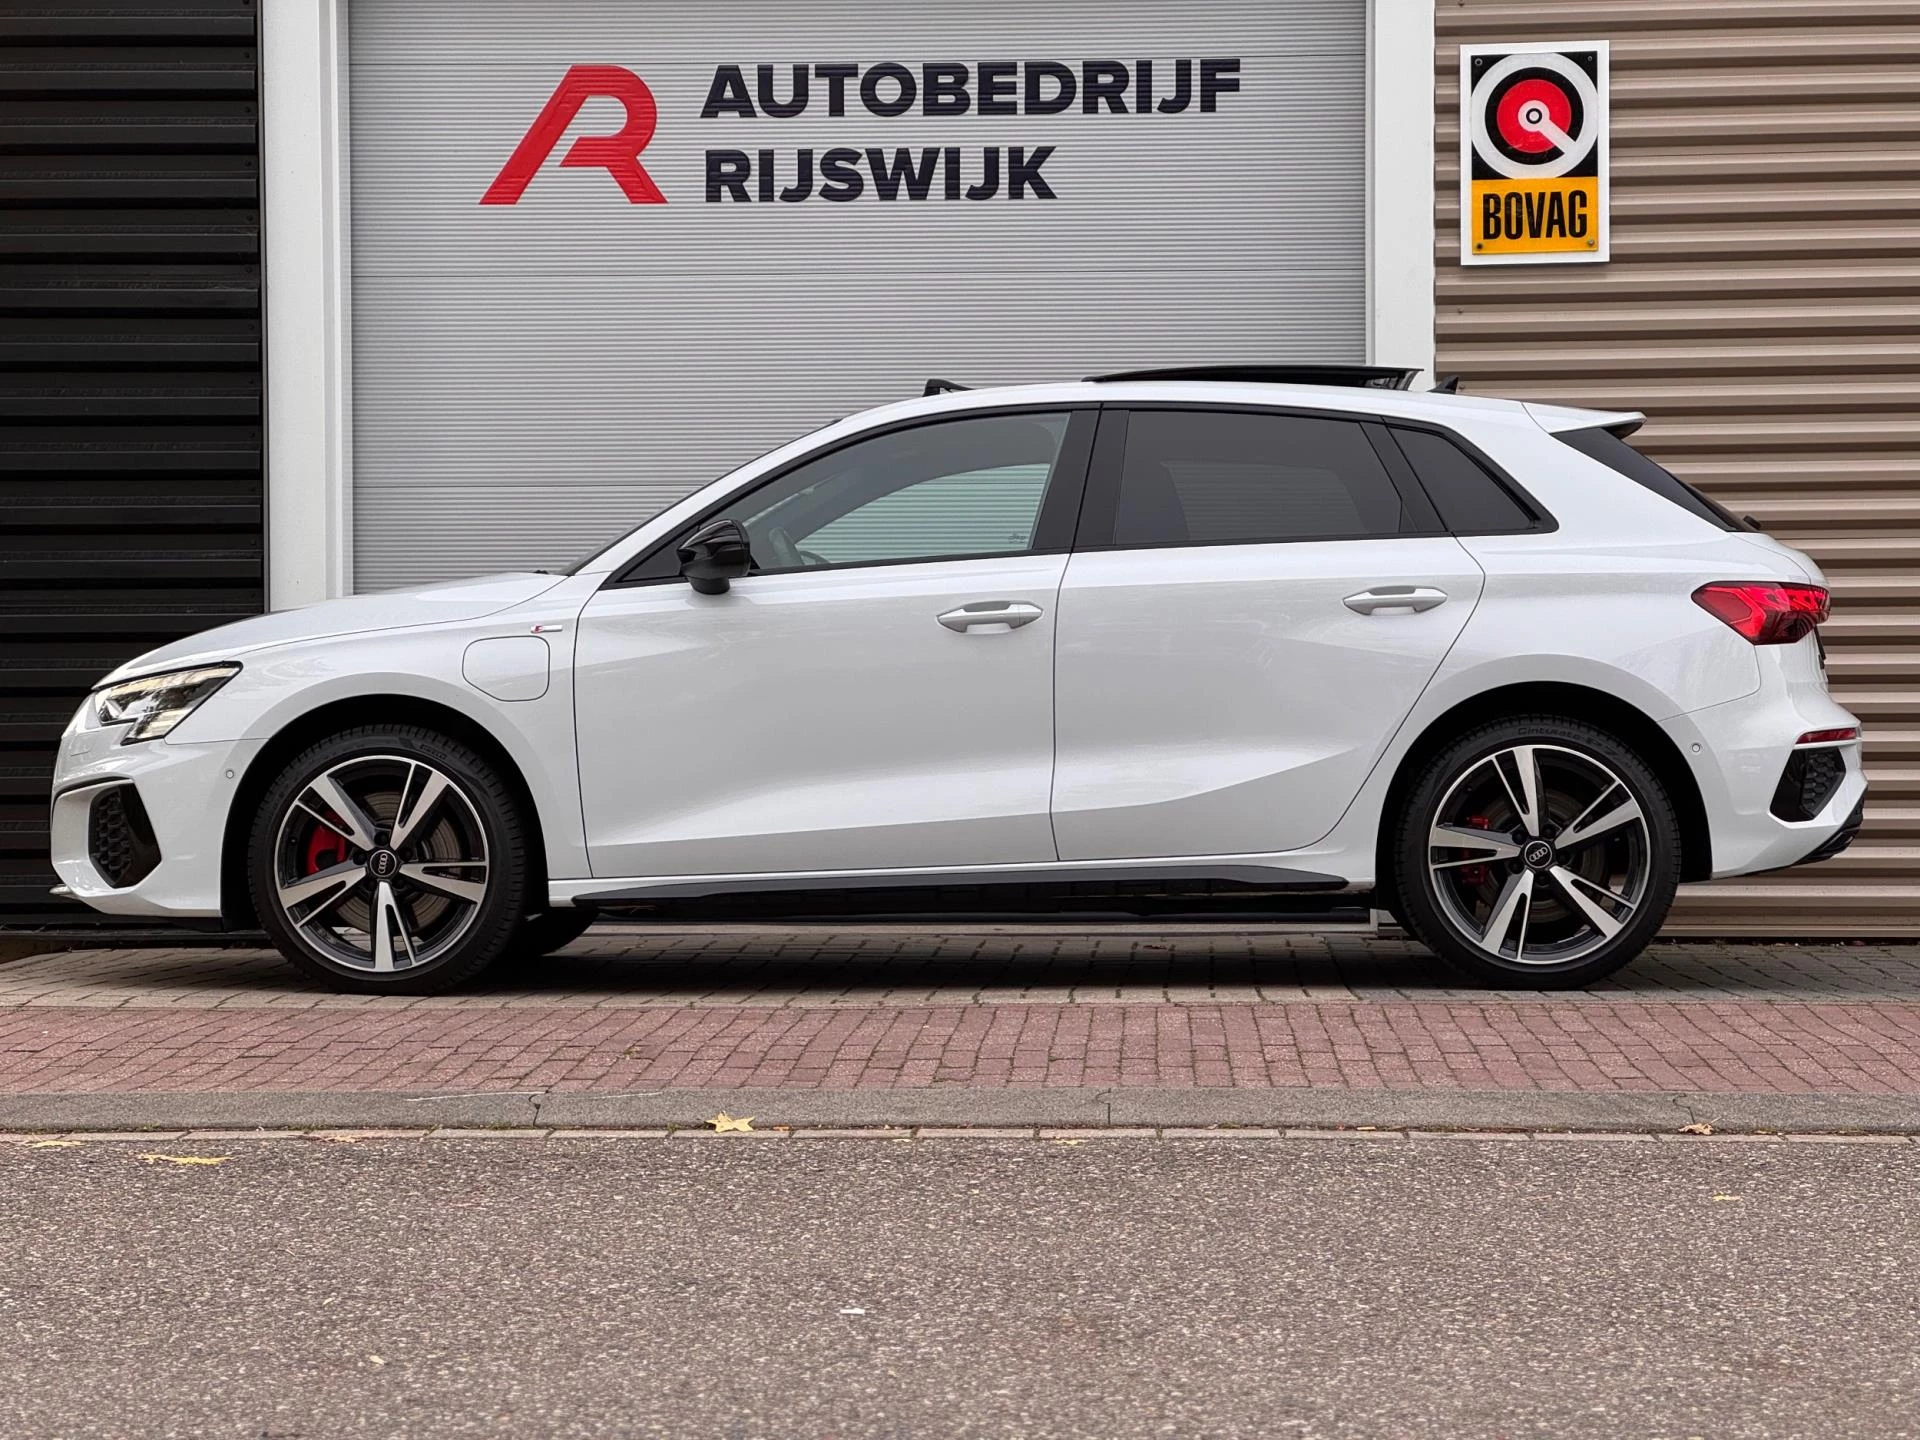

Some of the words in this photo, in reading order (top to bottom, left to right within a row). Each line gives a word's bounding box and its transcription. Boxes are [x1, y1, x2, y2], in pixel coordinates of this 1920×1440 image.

[700, 58, 1241, 118] AUTOBEDRIJF
[705, 146, 1057, 203] RIJSWIJK
[1482, 190, 1588, 240] BOVAG
